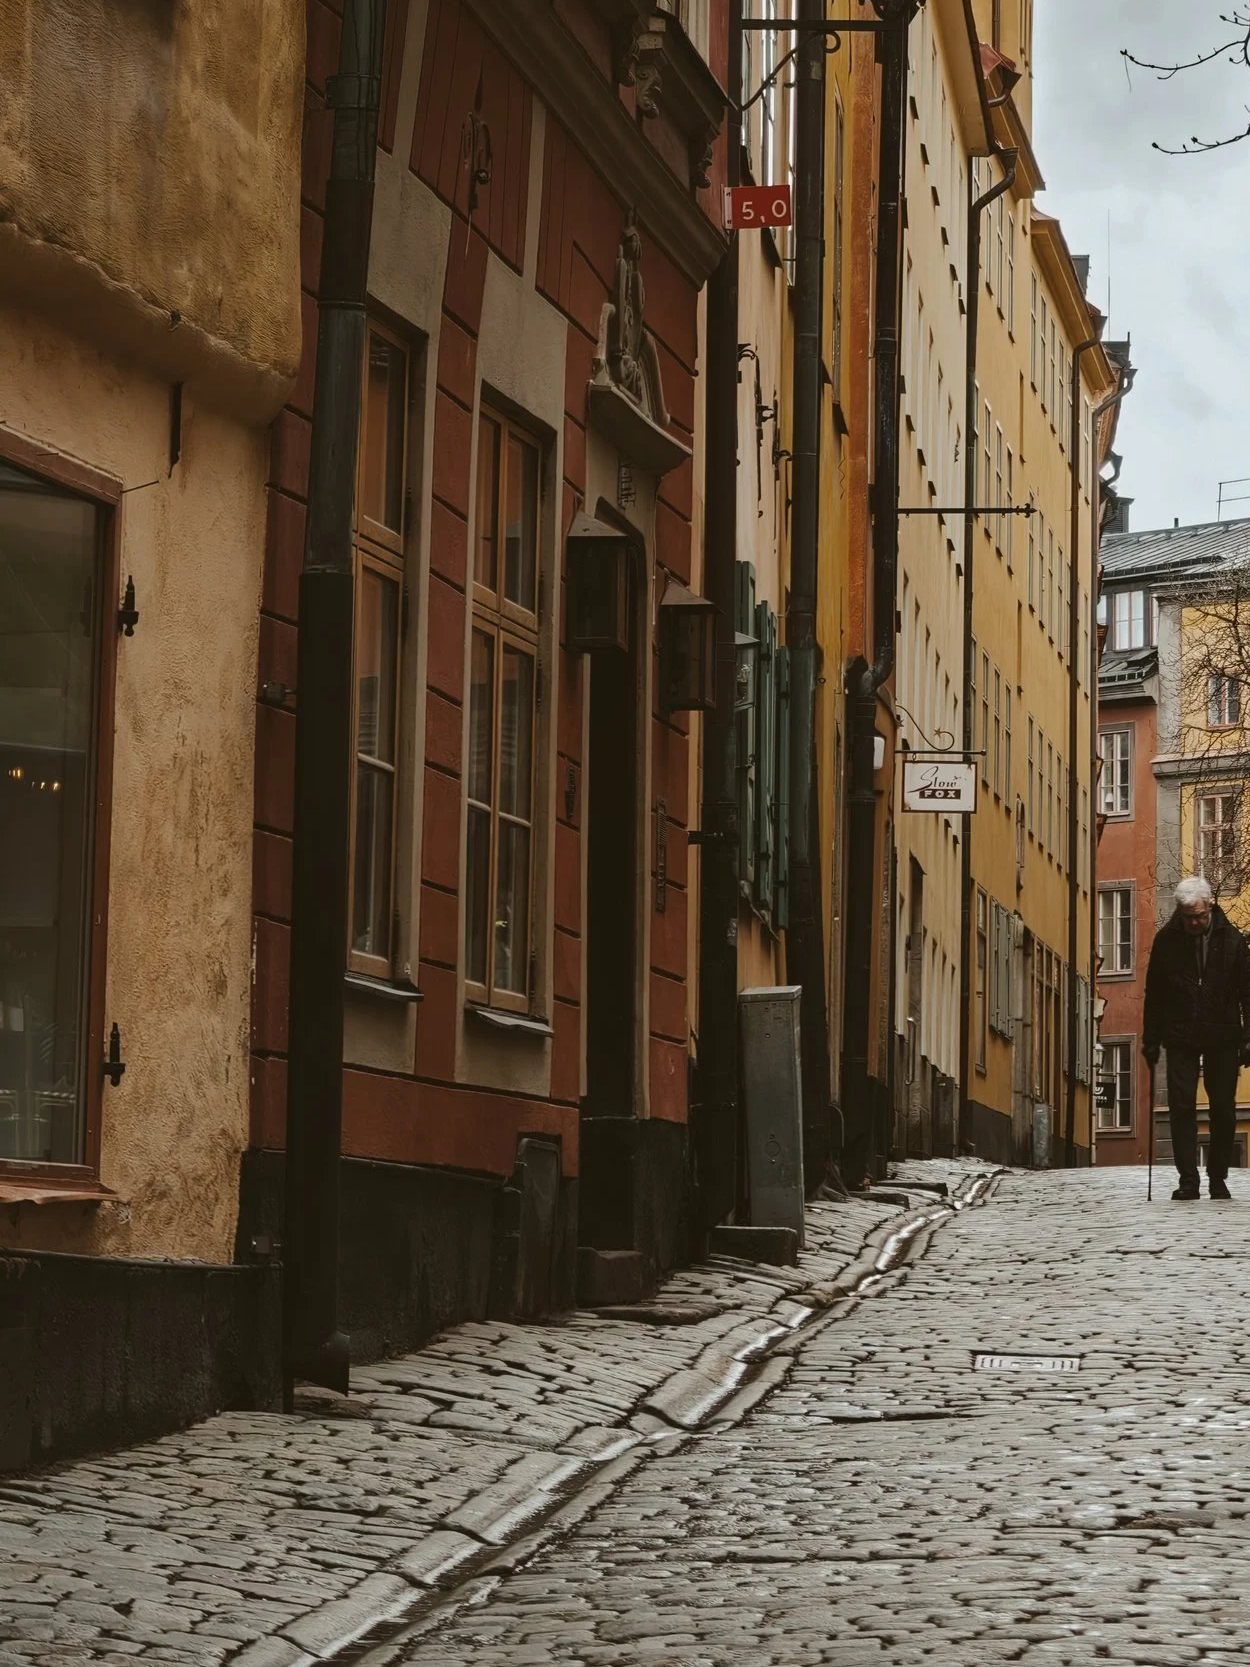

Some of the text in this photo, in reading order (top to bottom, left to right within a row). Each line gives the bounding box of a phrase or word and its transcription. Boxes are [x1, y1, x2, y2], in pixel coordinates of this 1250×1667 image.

[742, 199, 787, 223] 5,0
[906, 766, 957, 793] Slow
[924, 790, 956, 798] FOX
